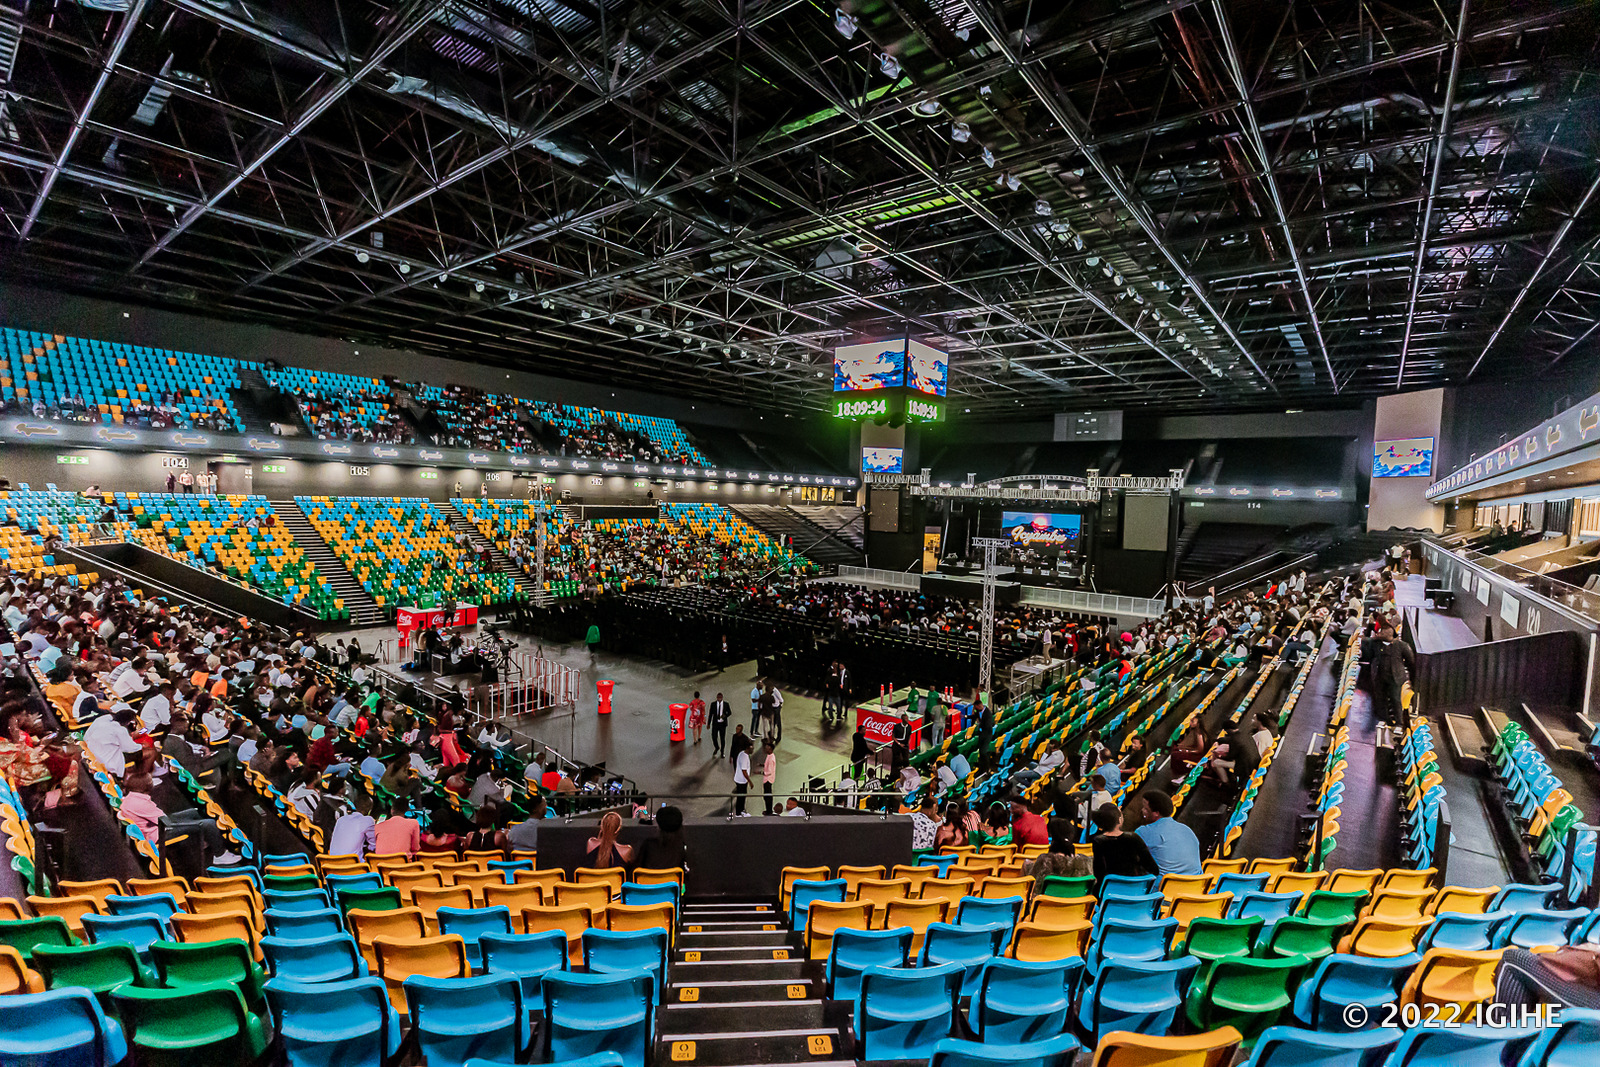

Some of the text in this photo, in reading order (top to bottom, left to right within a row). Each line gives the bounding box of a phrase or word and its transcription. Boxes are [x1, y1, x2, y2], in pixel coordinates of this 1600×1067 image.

[837, 399, 887, 417] 18:09:34
[908, 400, 938, 419] 18:09:34
[163, 457, 188, 468] 104
[351, 466, 368, 476] 105
[1247, 502, 1261, 510] 114
[1526, 606, 1541, 635] 120
[863, 716, 896, 737] Coca-Co
